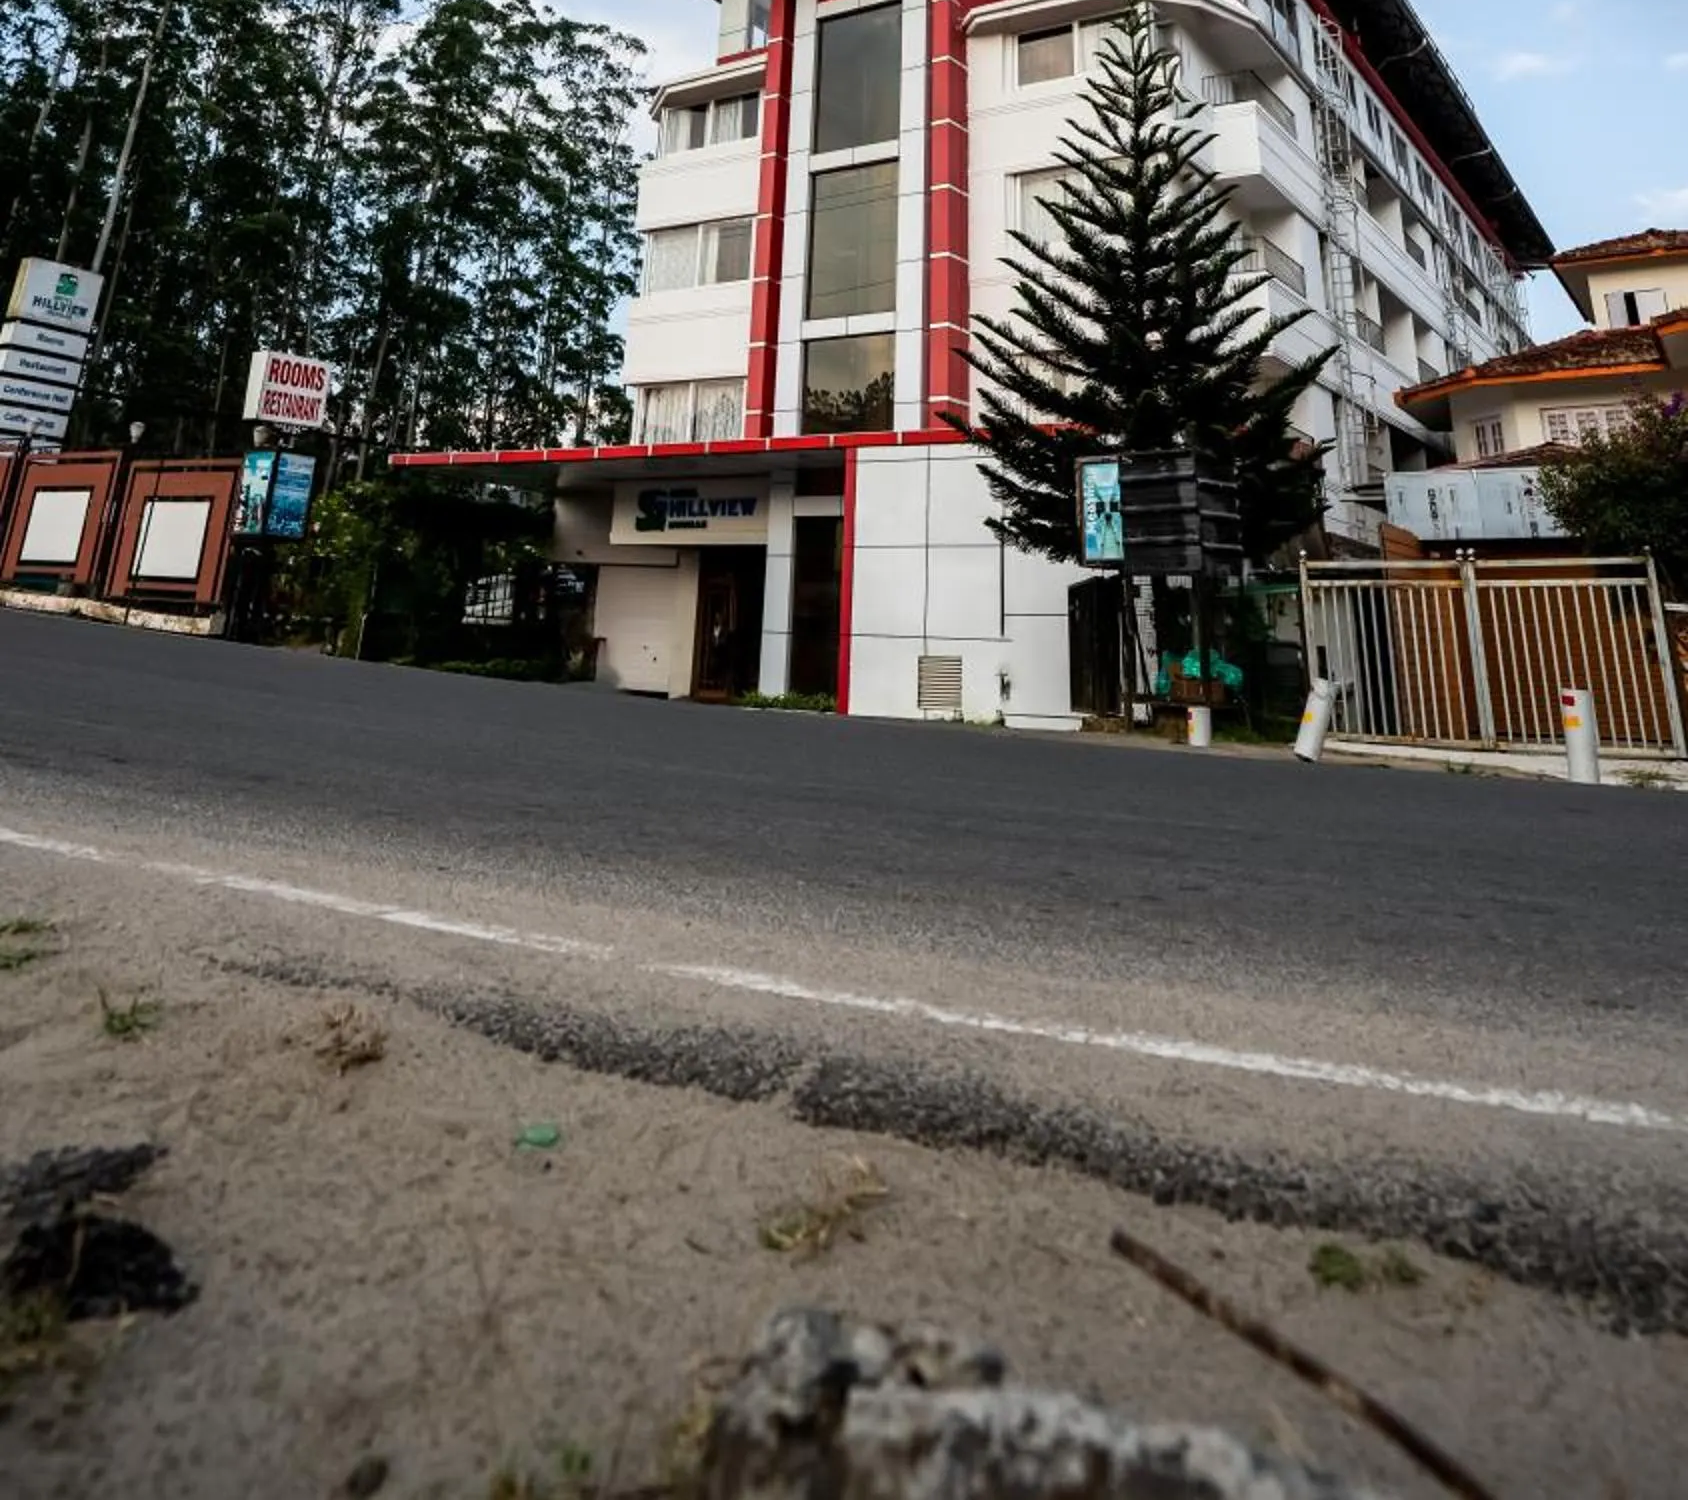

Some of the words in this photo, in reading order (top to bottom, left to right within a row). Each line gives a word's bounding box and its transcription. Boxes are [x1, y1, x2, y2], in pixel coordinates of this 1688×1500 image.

[268, 358, 326, 392] ROOMS
[261, 390, 322, 422] RESTAURANT
[668, 497, 758, 518] HILLVIEW
